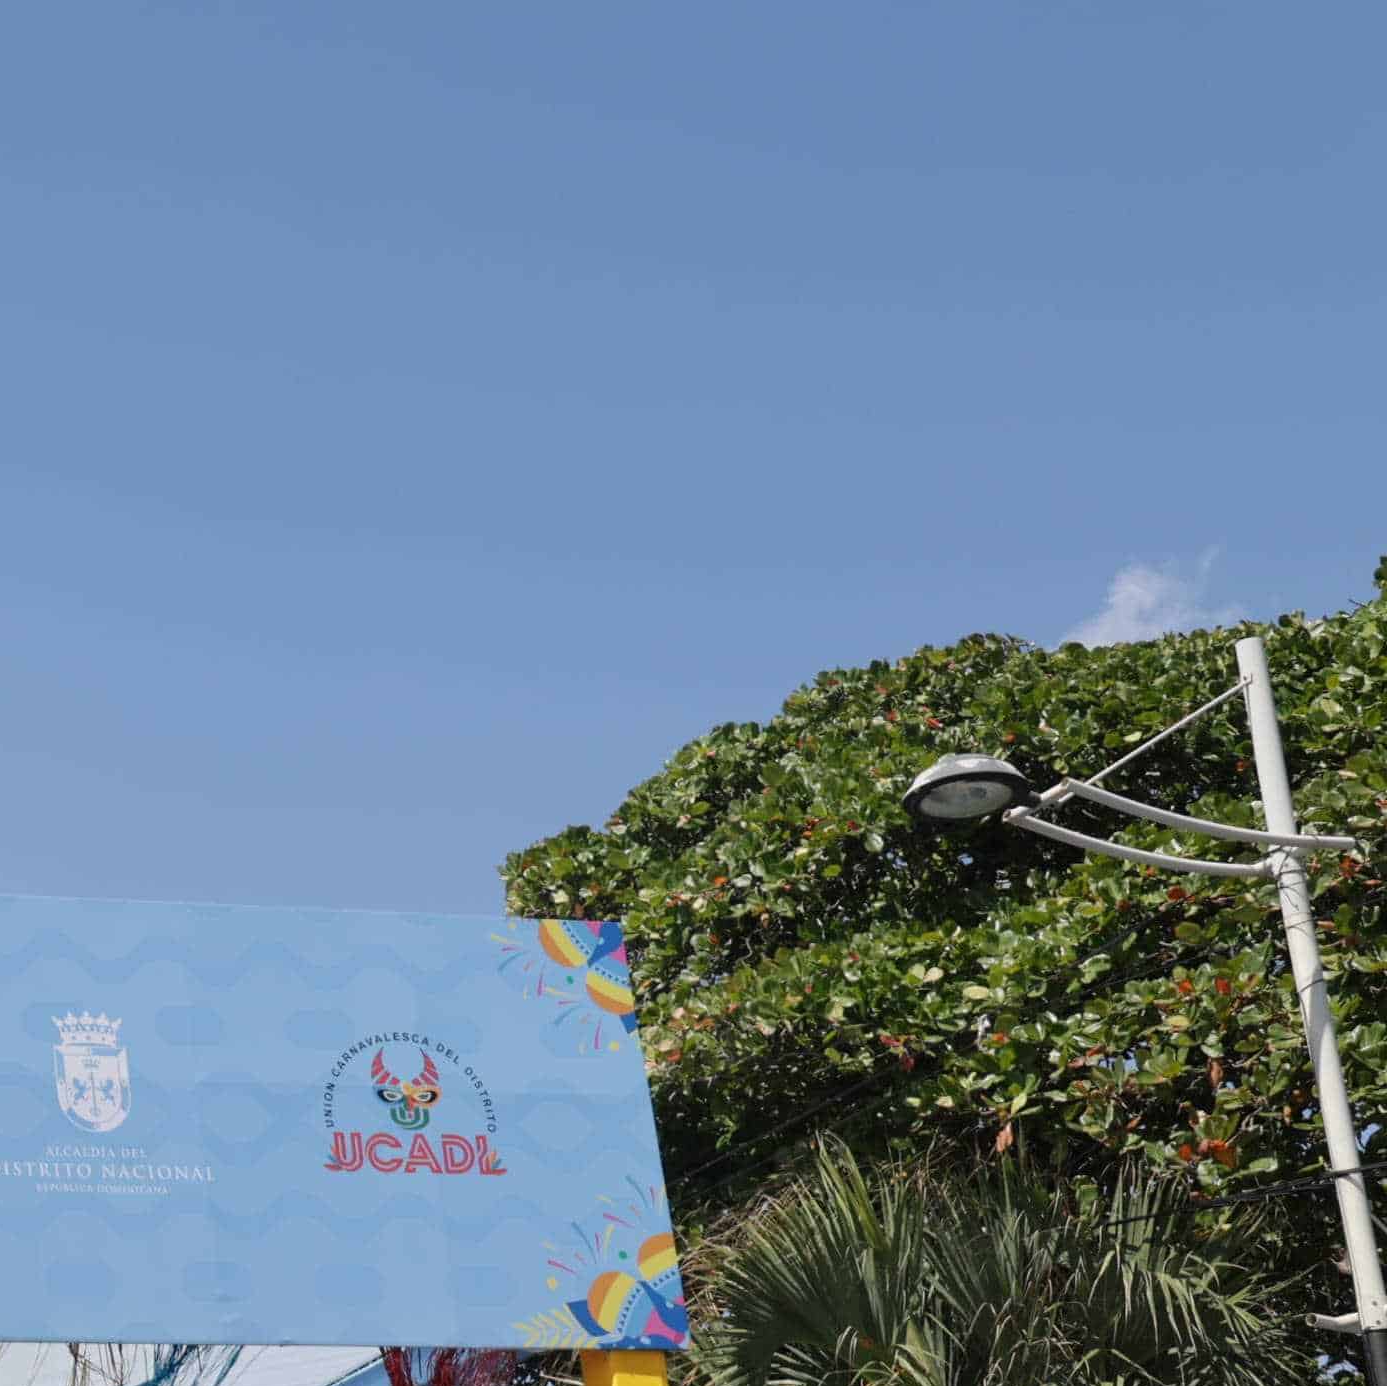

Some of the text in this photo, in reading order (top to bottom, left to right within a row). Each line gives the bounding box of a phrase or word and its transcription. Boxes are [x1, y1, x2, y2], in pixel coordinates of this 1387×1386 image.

[323, 1031, 497, 1134] UNION CARNAVALESCA DEL DISTRITO
[102, 1163, 216, 1182] NACIONAL
